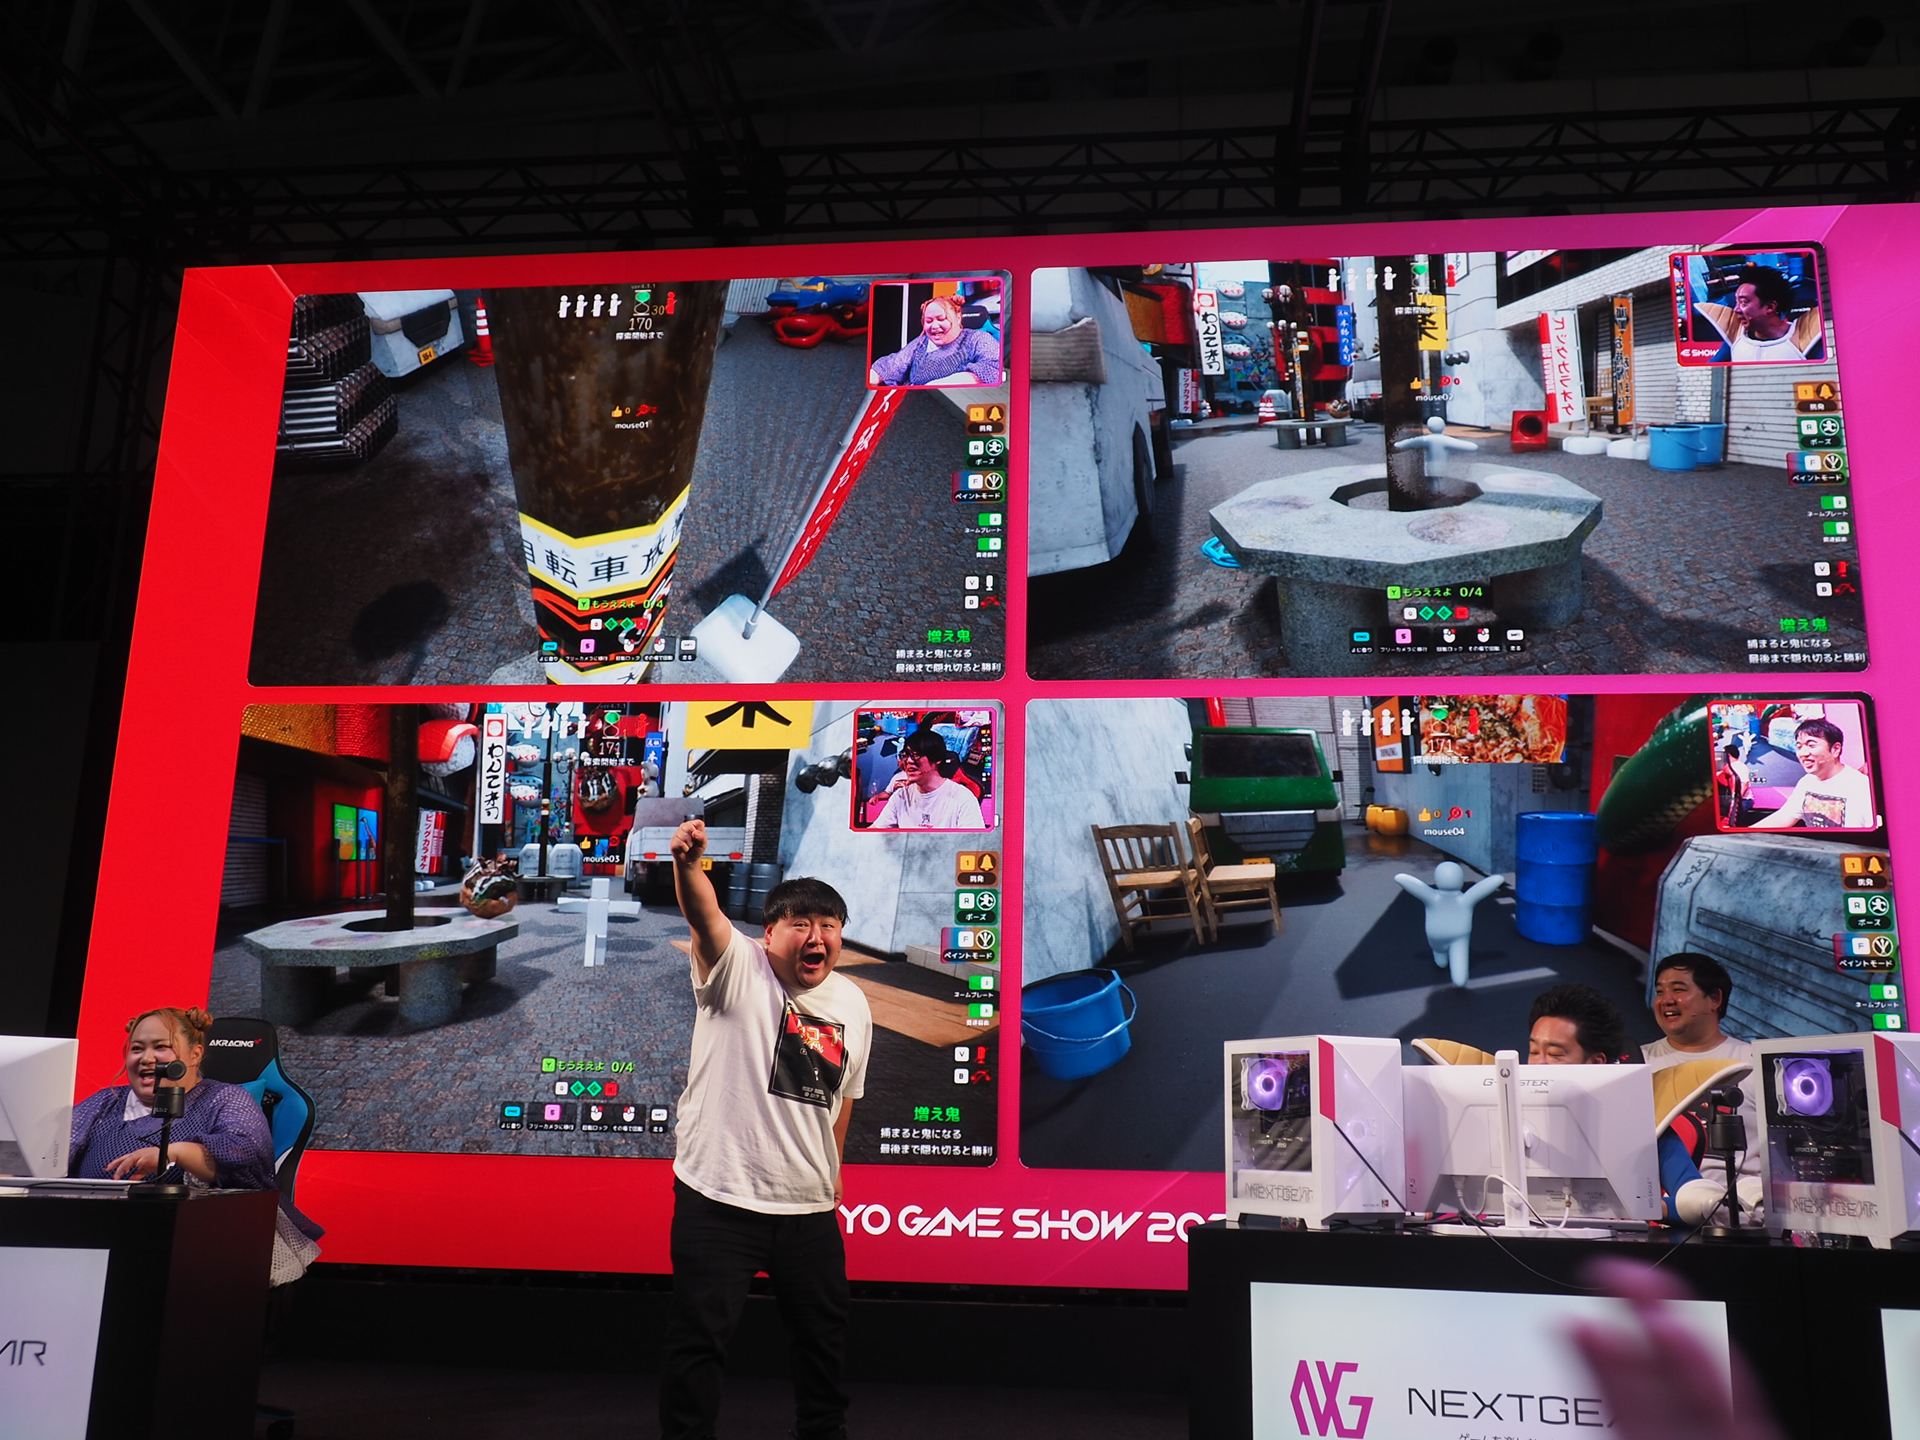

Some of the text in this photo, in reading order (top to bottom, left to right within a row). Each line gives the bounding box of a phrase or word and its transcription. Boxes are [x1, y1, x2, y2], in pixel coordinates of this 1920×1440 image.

[651, 305, 665, 316] 30
[628, 318, 653, 331] 170
[614, 420, 650, 430] mouse01
[1791, 473, 1843, 482] ペイントモード
[954, 492, 1001, 500] ペイントモード
[1459, 586, 1484, 597] 0/4
[927, 629, 972, 644] 増え鬼
[1423, 827, 1466, 836] mouse04
[583, 855, 621, 864] mouse03
[943, 952, 993, 960] ペイントモード
[1838, 959, 1894, 968] ペイントモード
[208, 1039, 255, 1048] AKRACING
[611, 1061, 635, 1073] 0/4
[1482, 1078, 1549, 1087] G-STER
[913, 1106, 961, 1122] 増え鬼
[897, 1205, 1005, 1239] GAME
[1012, 1208, 1144, 1242] SHOW
[1147, 1213, 1226, 1243] 20
[1408, 1387, 1616, 1428] NEXTGE
